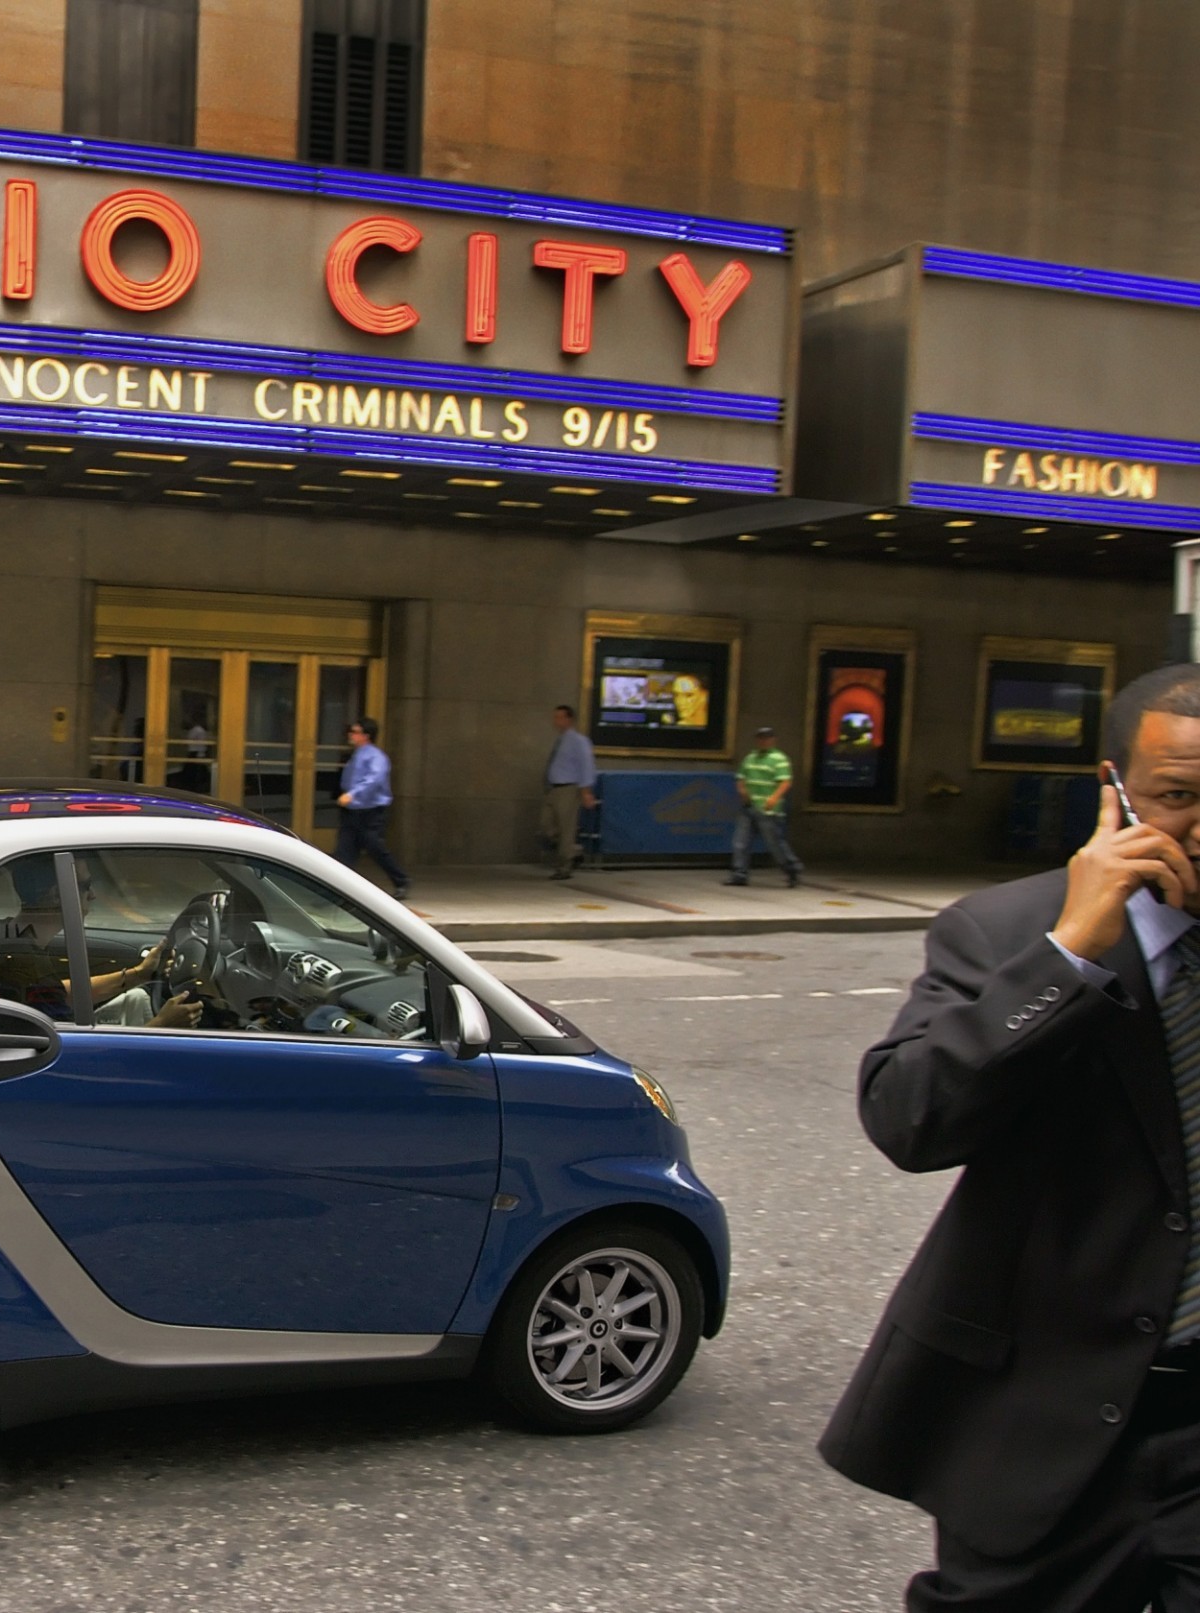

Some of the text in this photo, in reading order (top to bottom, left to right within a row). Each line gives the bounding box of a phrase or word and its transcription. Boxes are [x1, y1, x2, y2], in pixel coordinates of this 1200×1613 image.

[325, 215, 752, 367] CITY
[254, 378, 529, 442] CRIMINALS
[562, 406, 657, 453] 9/15
[982, 448, 1158, 499] FASHION
